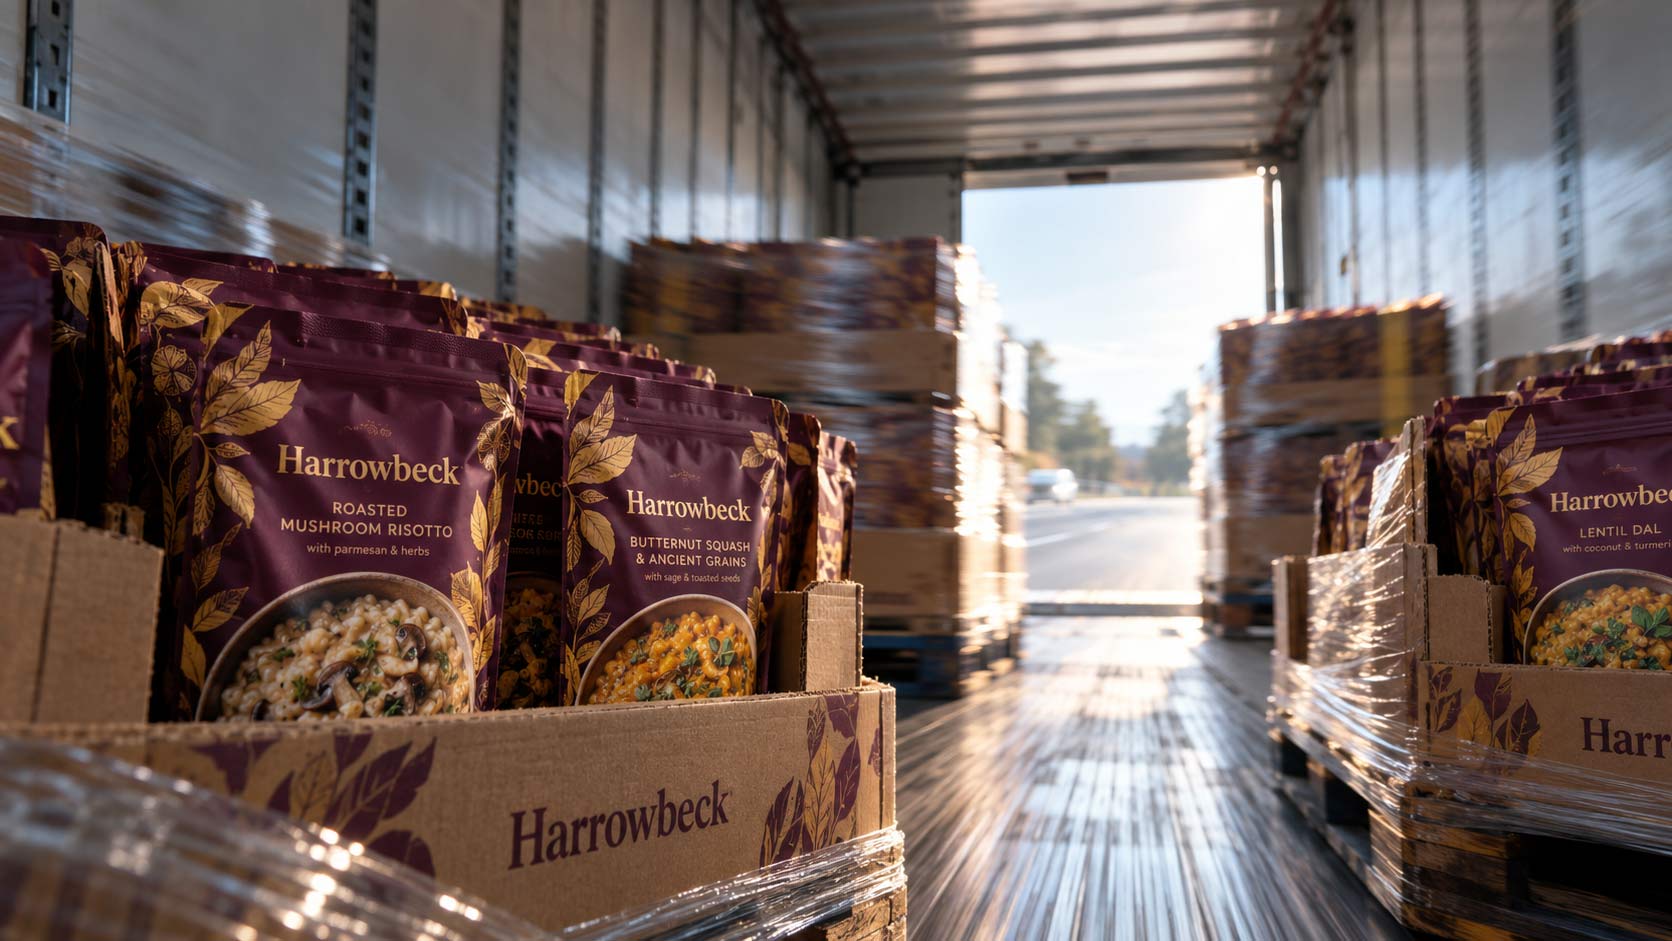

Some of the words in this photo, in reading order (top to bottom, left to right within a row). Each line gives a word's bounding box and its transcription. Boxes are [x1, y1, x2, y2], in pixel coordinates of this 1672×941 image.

[276, 444, 461, 485] Harrowbeck
[332, 501, 408, 517] ROASTED
[626, 489, 752, 522] Harrowbeck
[280, 518, 381, 535] MUSHROOM
[388, 523, 453, 538] RISOTTO
[1580, 526, 1628, 539] LENTIL
[1632, 523, 1662, 536] DAL
[307, 543, 331, 554] with
[334, 545, 388, 557] parmesan
[390, 546, 399, 556] &
[401, 545, 430, 557] herbs
[630, 536, 702, 550] BUTTERNUT
[706, 539, 750, 553] SQUASH
[1562, 544, 1582, 553] with
[1584, 543, 1621, 553] coconut
[1624, 542, 1632, 550] &
[1634, 539, 1672, 550] turmeri
[636, 553, 645, 565] &
[649, 554, 702, 566] ANCIENT
[705, 556, 747, 568] GRAINS
[644, 572, 662, 582] with
[664, 574, 682, 584] sage
[683, 573, 690, 582] &
[691, 573, 719, 583] toasted
[721, 574, 741, 583] seeds
[1580, 716, 1672, 759] Harr
[508, 780, 729, 871] Harrowbeck
